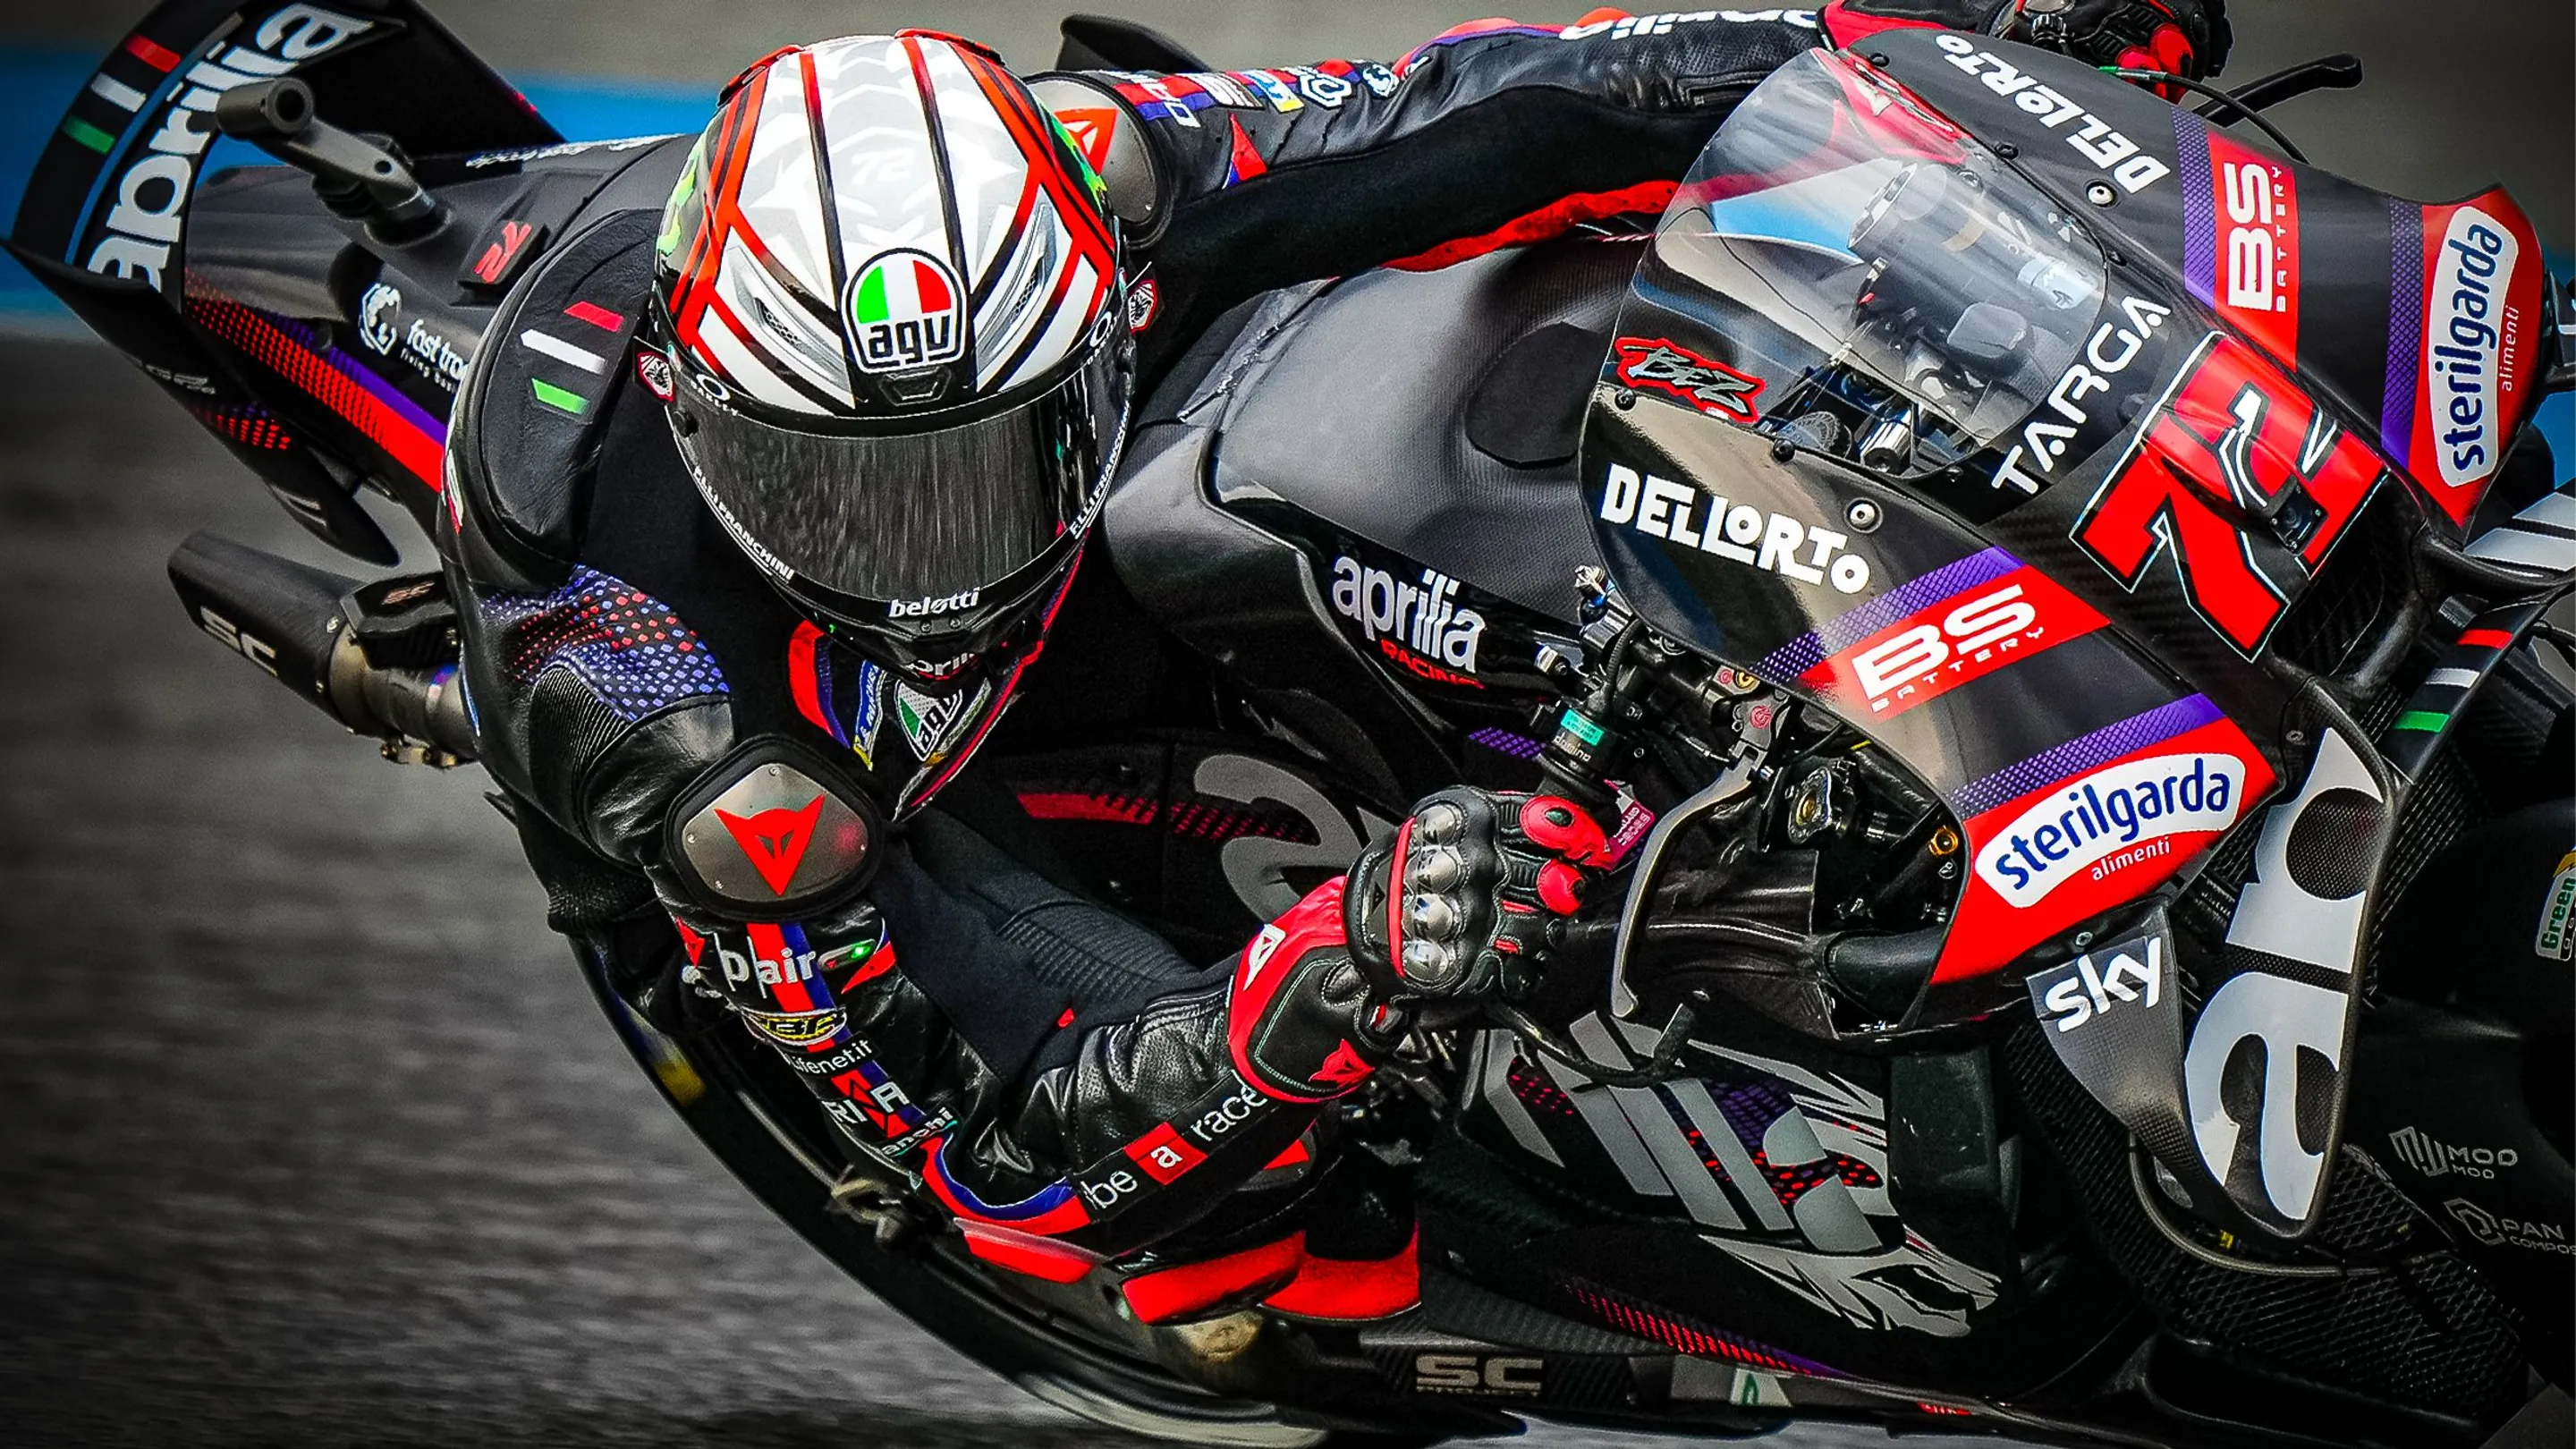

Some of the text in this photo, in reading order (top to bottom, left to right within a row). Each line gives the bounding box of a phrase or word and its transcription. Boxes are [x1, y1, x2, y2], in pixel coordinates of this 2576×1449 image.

[1936, 33, 2170, 194] DELLORTO
[2224, 162, 2274, 310] BS
[2275, 165, 2285, 314] BATTERY
[869, 314, 950, 364] agv
[2448, 224, 2503, 472] sterilgarda
[2501, 305, 2521, 392] alimenti
[1990, 295, 2172, 495] TARGA
[1599, 463, 1871, 595] DELLORTO
[889, 586, 980, 618] belotti
[1332, 556, 1487, 674] aprilia
[1851, 583, 2036, 700] BS
[1870, 626, 2045, 713] BATTERY
[1996, 758, 2231, 890] sterilgarda
[2090, 835, 2172, 882] alimenti
[2045, 936, 2163, 1032] sky
[1191, 1085, 1268, 1142] race
[2501, 1218, 2565, 1241] PAN
[1416, 1355, 1543, 1391] SC
